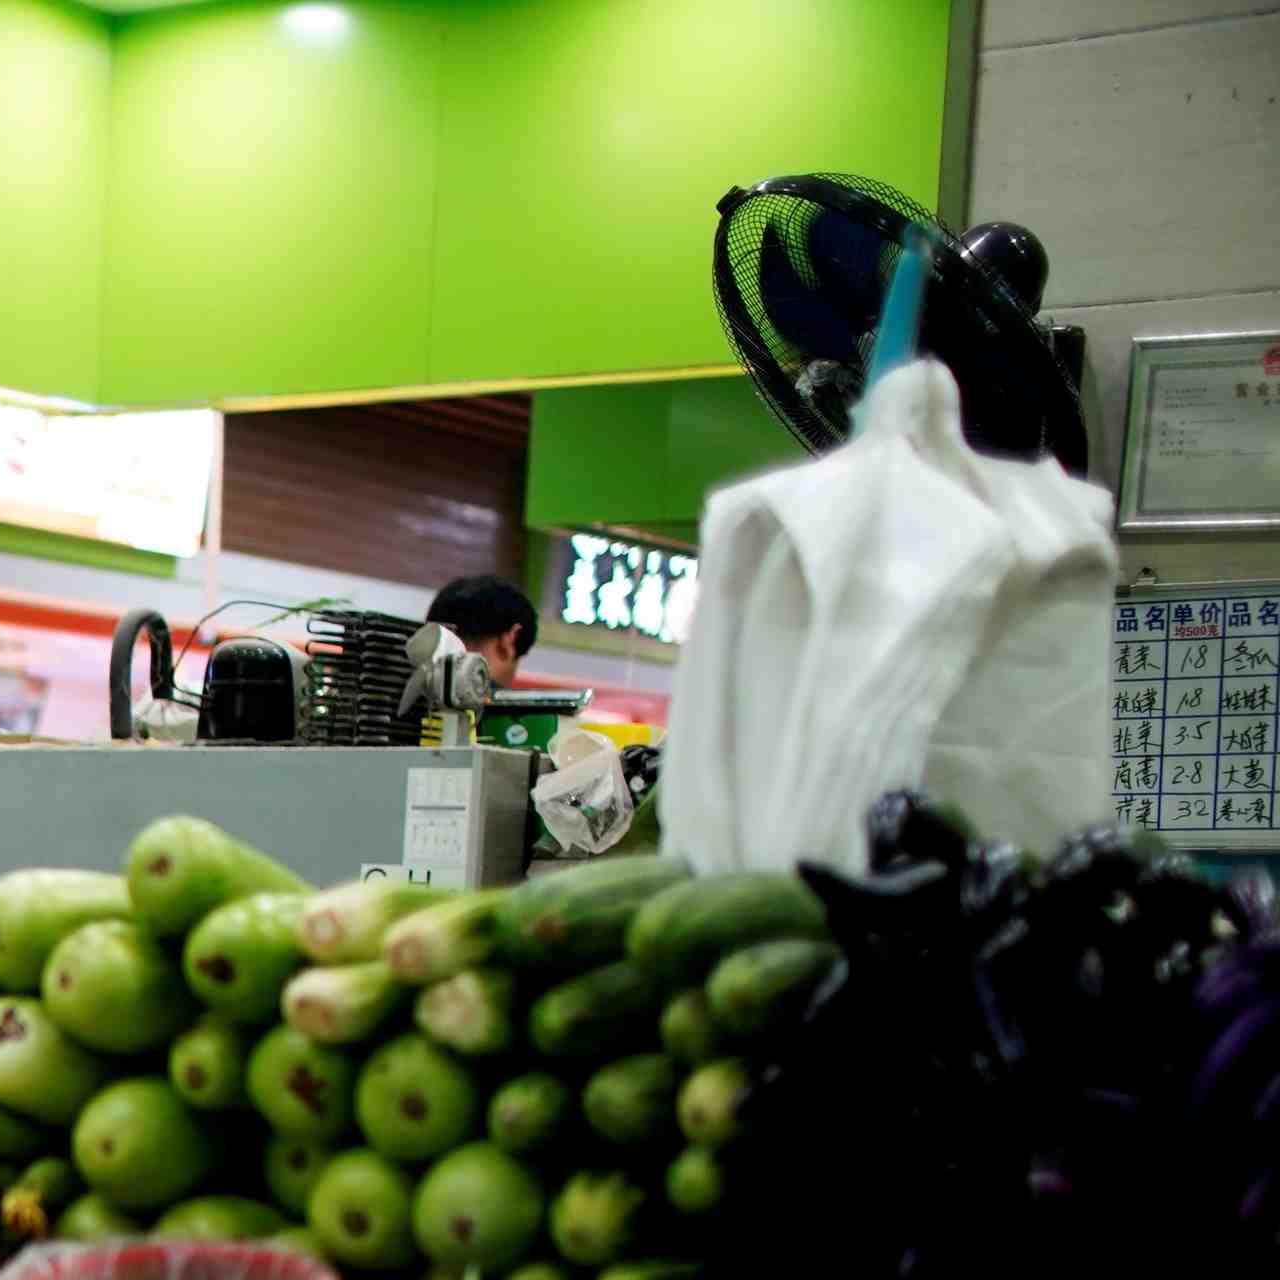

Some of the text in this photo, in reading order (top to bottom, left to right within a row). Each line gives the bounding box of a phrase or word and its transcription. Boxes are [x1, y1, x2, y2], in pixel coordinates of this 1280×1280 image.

[1116, 601, 1280, 632] 品名 单价 品名
[1181, 645, 1208, 673] 1.8
[1176, 688, 1202, 714] 1.8
[1173, 721, 1212, 746] 3.5
[1171, 761, 1202, 785] 2.8
